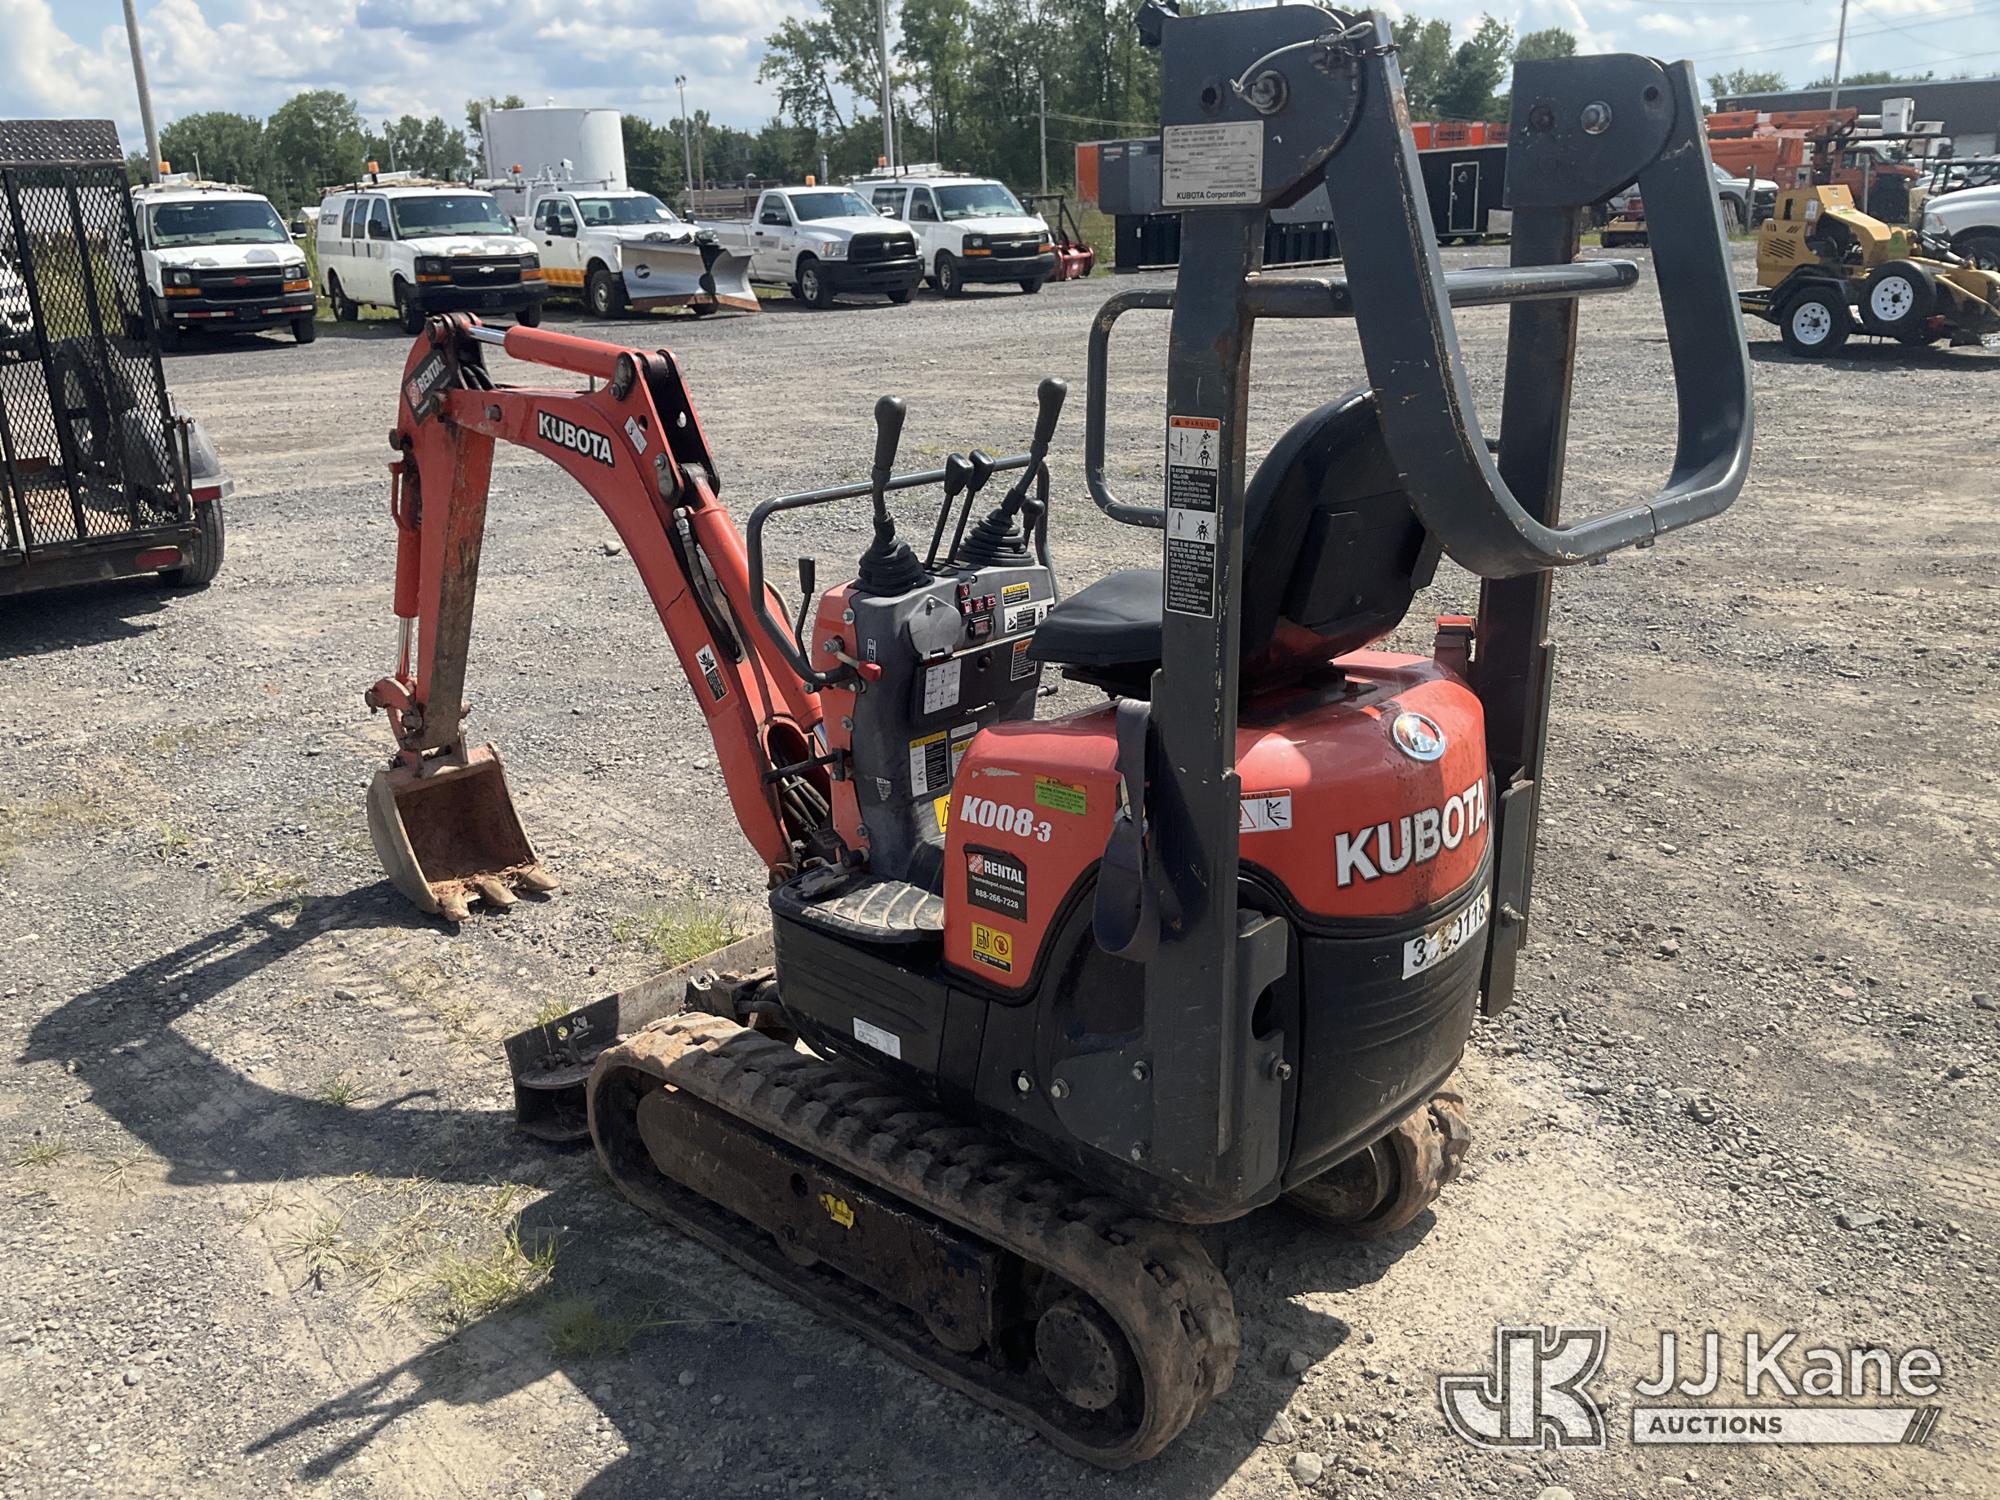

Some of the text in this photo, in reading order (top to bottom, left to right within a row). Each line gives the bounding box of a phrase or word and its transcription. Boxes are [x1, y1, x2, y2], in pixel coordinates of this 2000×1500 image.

[1176, 190, 1246, 200] KUBOTA Corporation
[416, 354, 447, 391] RENTAL
[538, 411, 614, 465] KUBOTA
[959, 794, 1053, 843] K008-3
[1334, 777, 1486, 888] KUBOTA
[984, 859, 1025, 885] RENTAL
[974, 888, 1019, 909] 888-266-7228
